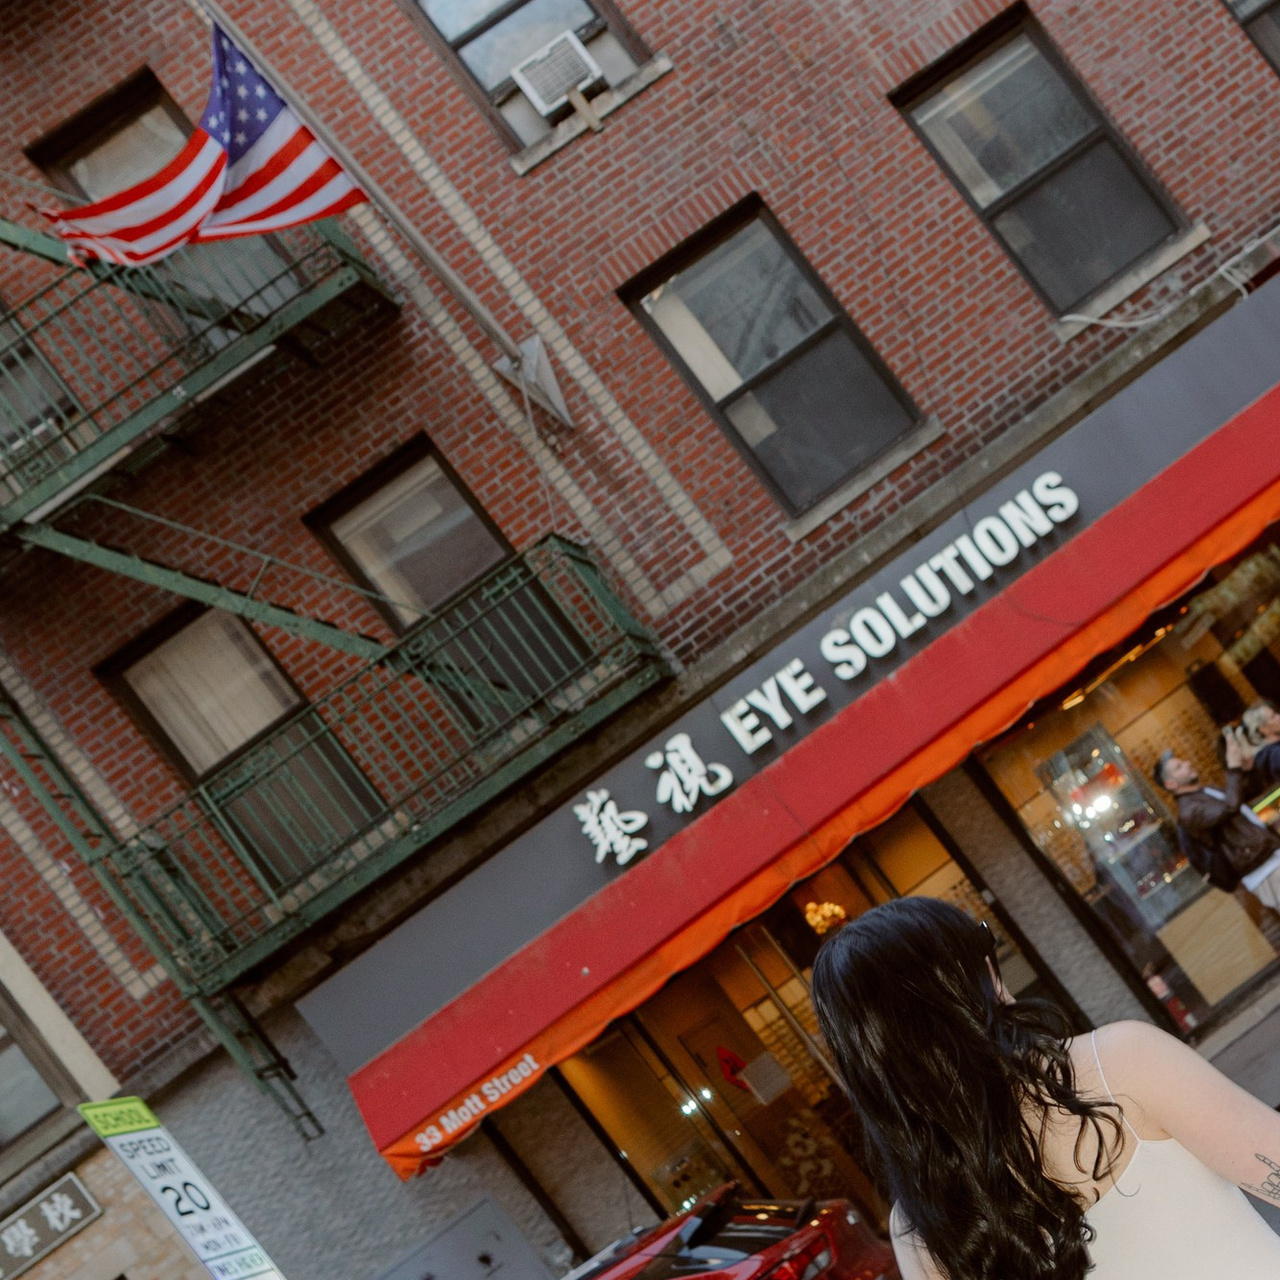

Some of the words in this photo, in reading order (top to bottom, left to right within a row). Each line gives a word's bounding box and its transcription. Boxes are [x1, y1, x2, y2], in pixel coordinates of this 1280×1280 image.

[719, 657, 828, 755] EYE
[819, 471, 1080, 681] SOLUTIONS
[93, 1106, 152, 1129] SCHOOL
[415, 1124, 443, 1152] 33
[438, 1093, 487, 1134] Mott
[481, 1053, 541, 1103] Street
[118, 1136, 171, 1159] SPEED
[140, 1159, 183, 1180] LIMIT
[161, 1182, 211, 1216] 20
[0, 1191, 82, 1277] 學校
